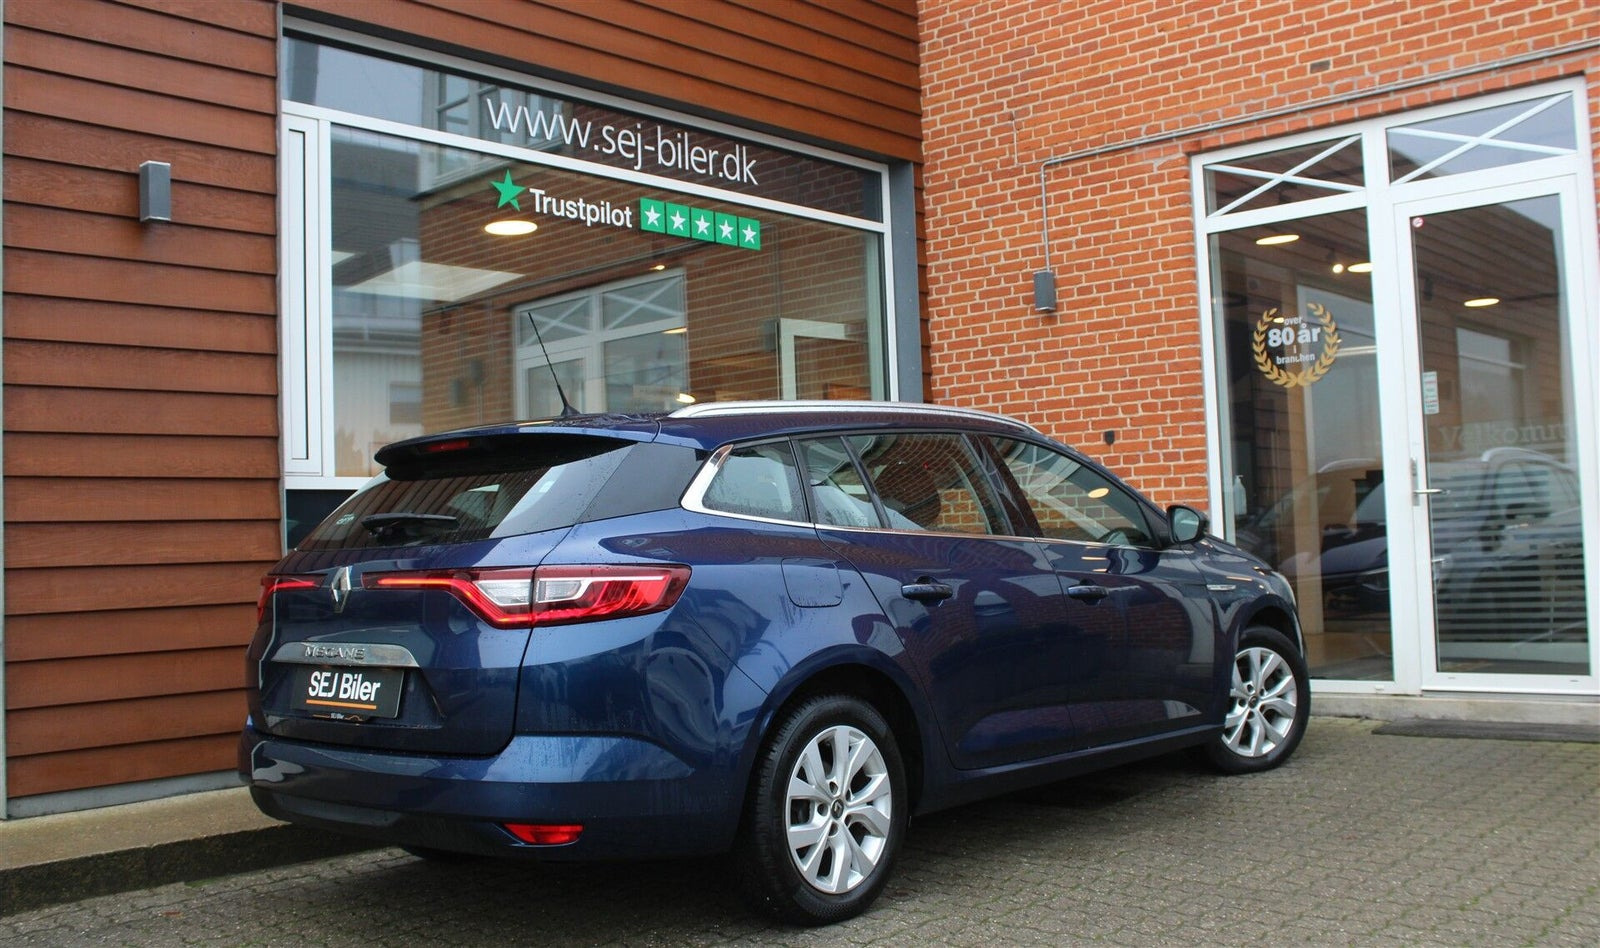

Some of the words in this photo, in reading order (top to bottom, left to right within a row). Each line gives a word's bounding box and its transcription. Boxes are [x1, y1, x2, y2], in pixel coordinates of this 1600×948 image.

[486, 98, 759, 185] www.sej-biler.dk
[529, 187, 632, 228] Trustpilot
[1268, 327, 1295, 347] 80
[1297, 323, 1321, 343] år
[1284, 317, 1302, 325] over
[308, 671, 339, 698] SEJ
[339, 673, 381, 701] Biler
